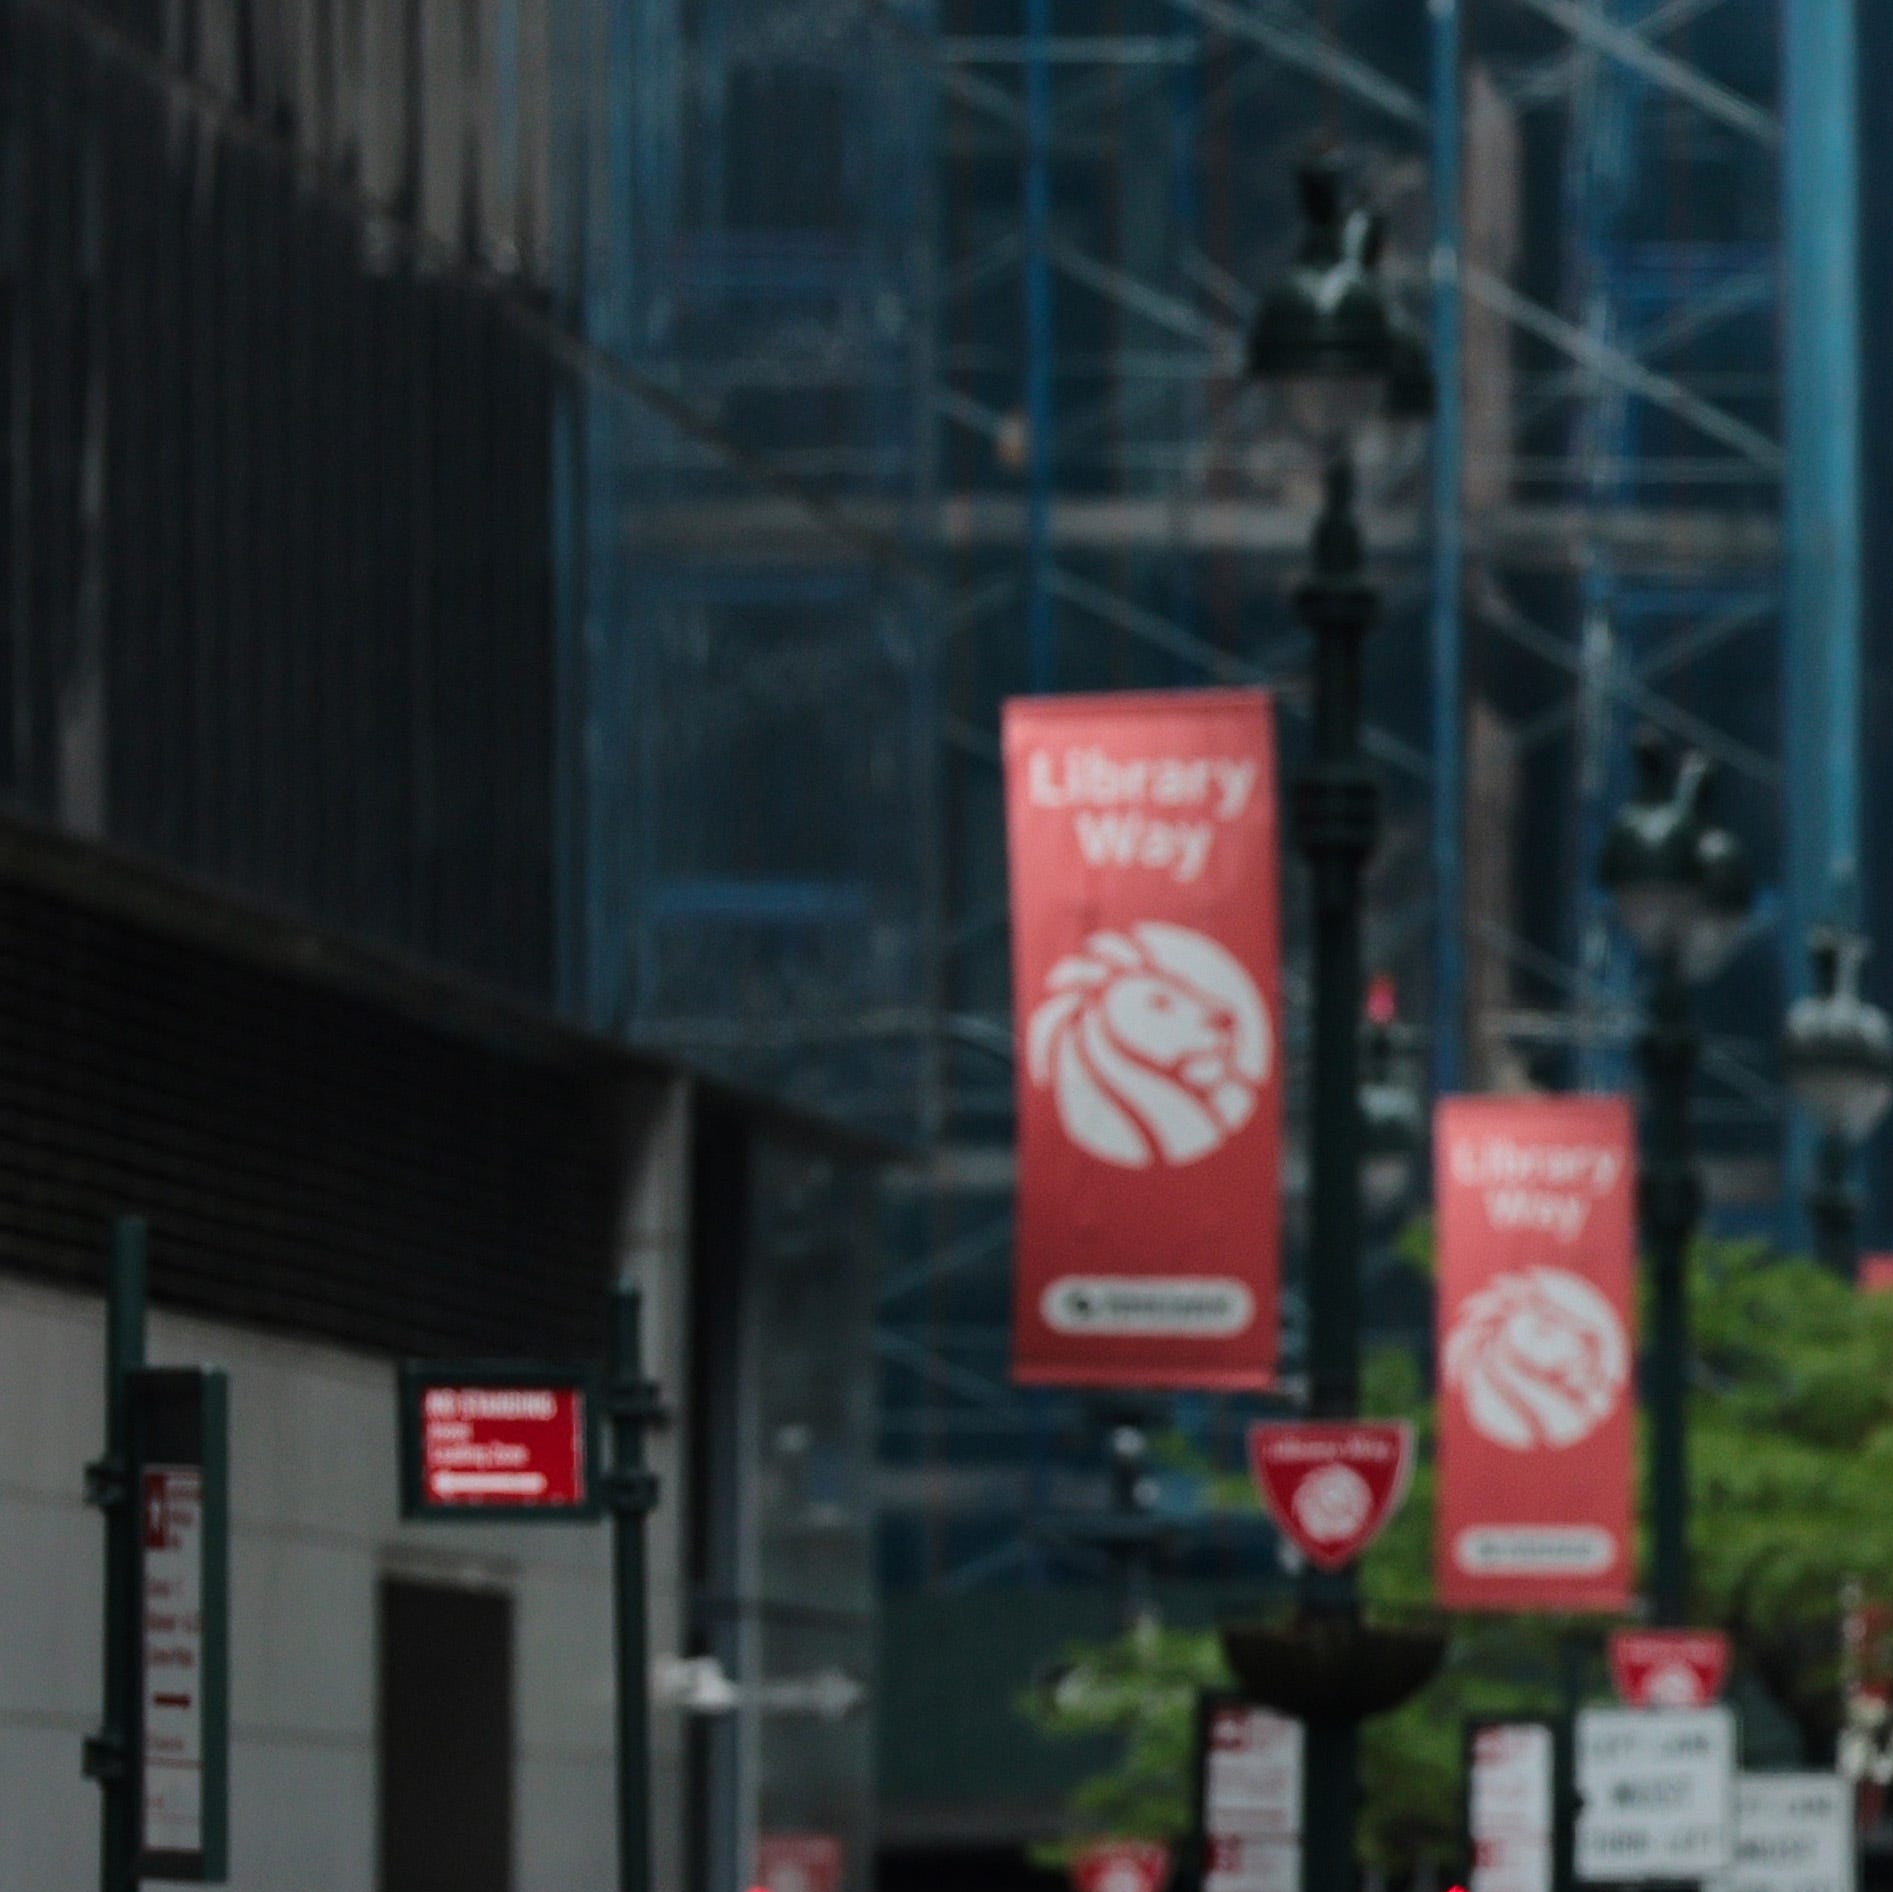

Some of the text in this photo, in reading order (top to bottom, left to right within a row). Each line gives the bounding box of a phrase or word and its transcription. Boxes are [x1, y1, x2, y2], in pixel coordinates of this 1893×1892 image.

[1029, 748, 1255, 822] Library
[1075, 814, 1212, 882] Way
[1451, 1138, 1619, 1195] Library
[1487, 1190, 1589, 1242] Way
